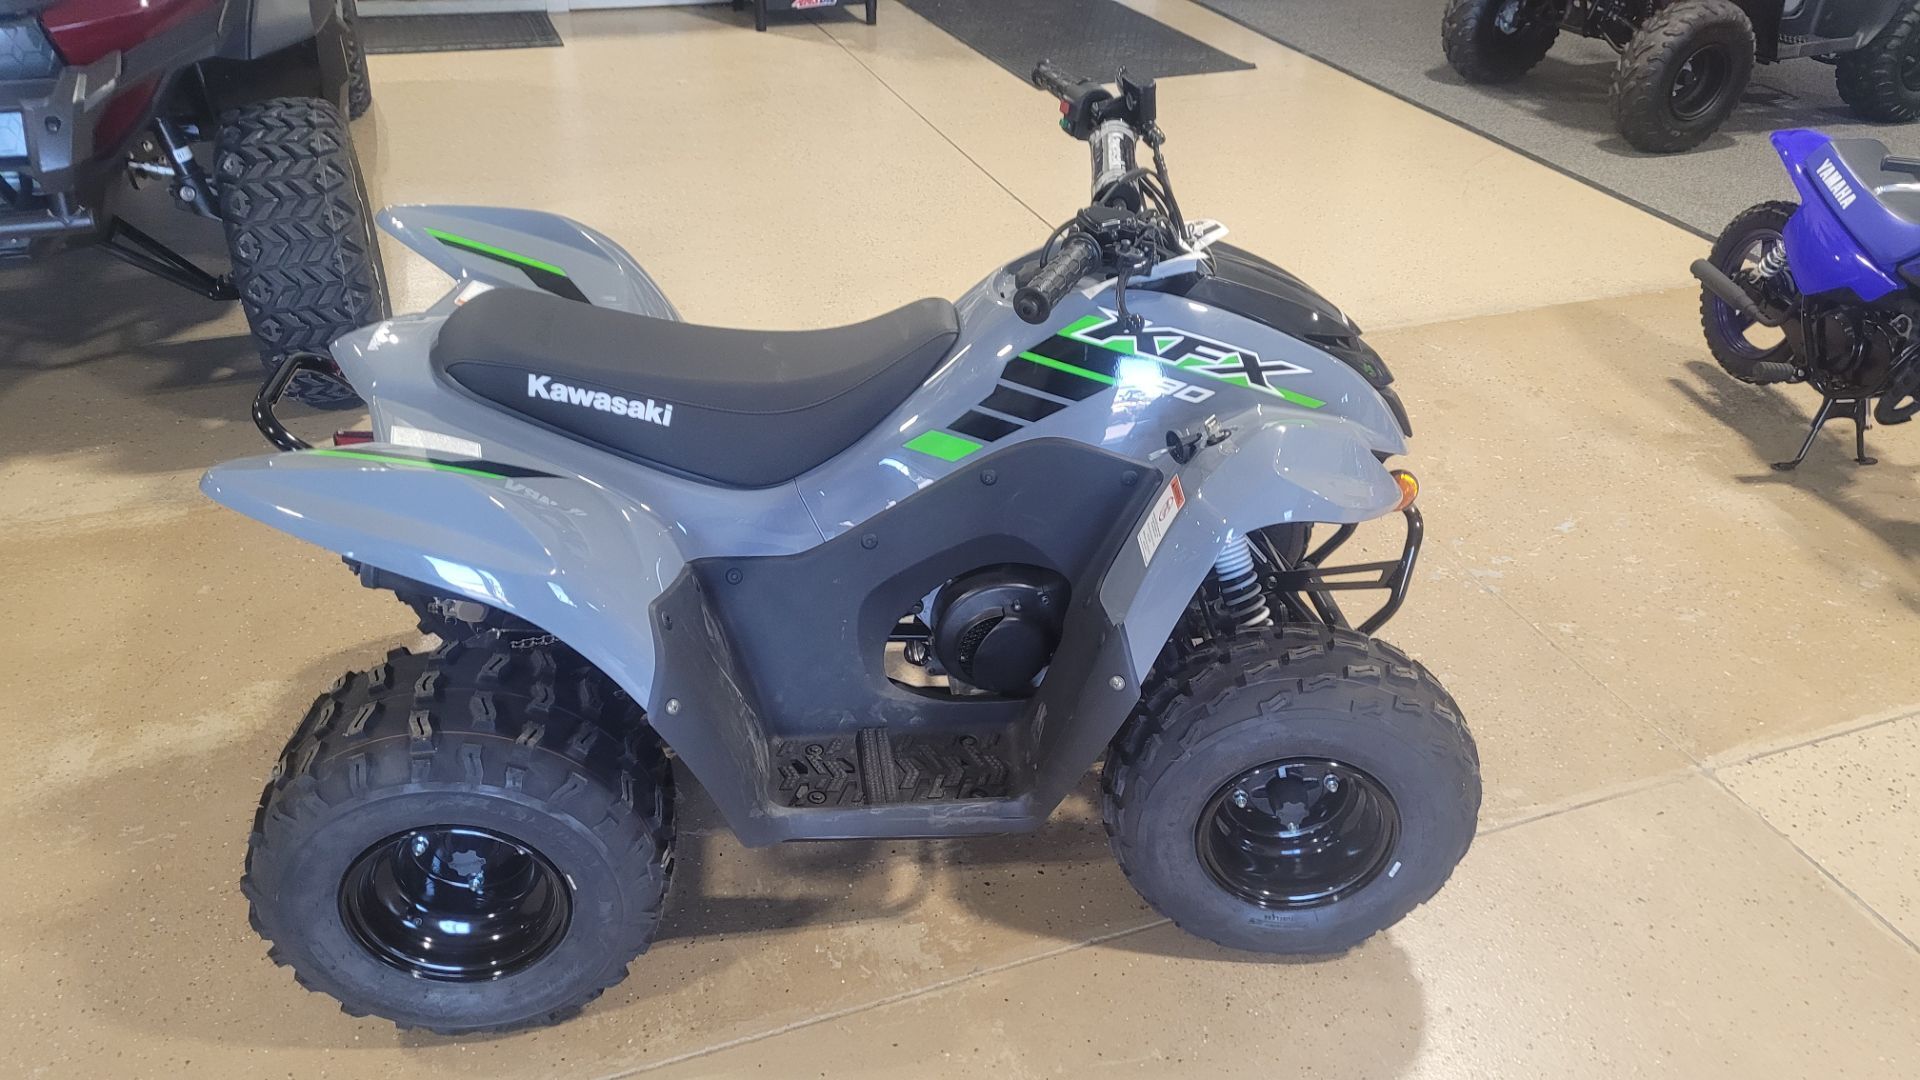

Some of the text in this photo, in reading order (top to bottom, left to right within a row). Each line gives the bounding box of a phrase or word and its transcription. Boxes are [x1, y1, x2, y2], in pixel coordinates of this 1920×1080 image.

[1816, 158, 1857, 210] YAMAHA
[1069, 305, 1313, 398] KFX
[527, 373, 673, 427] Kawasaki
